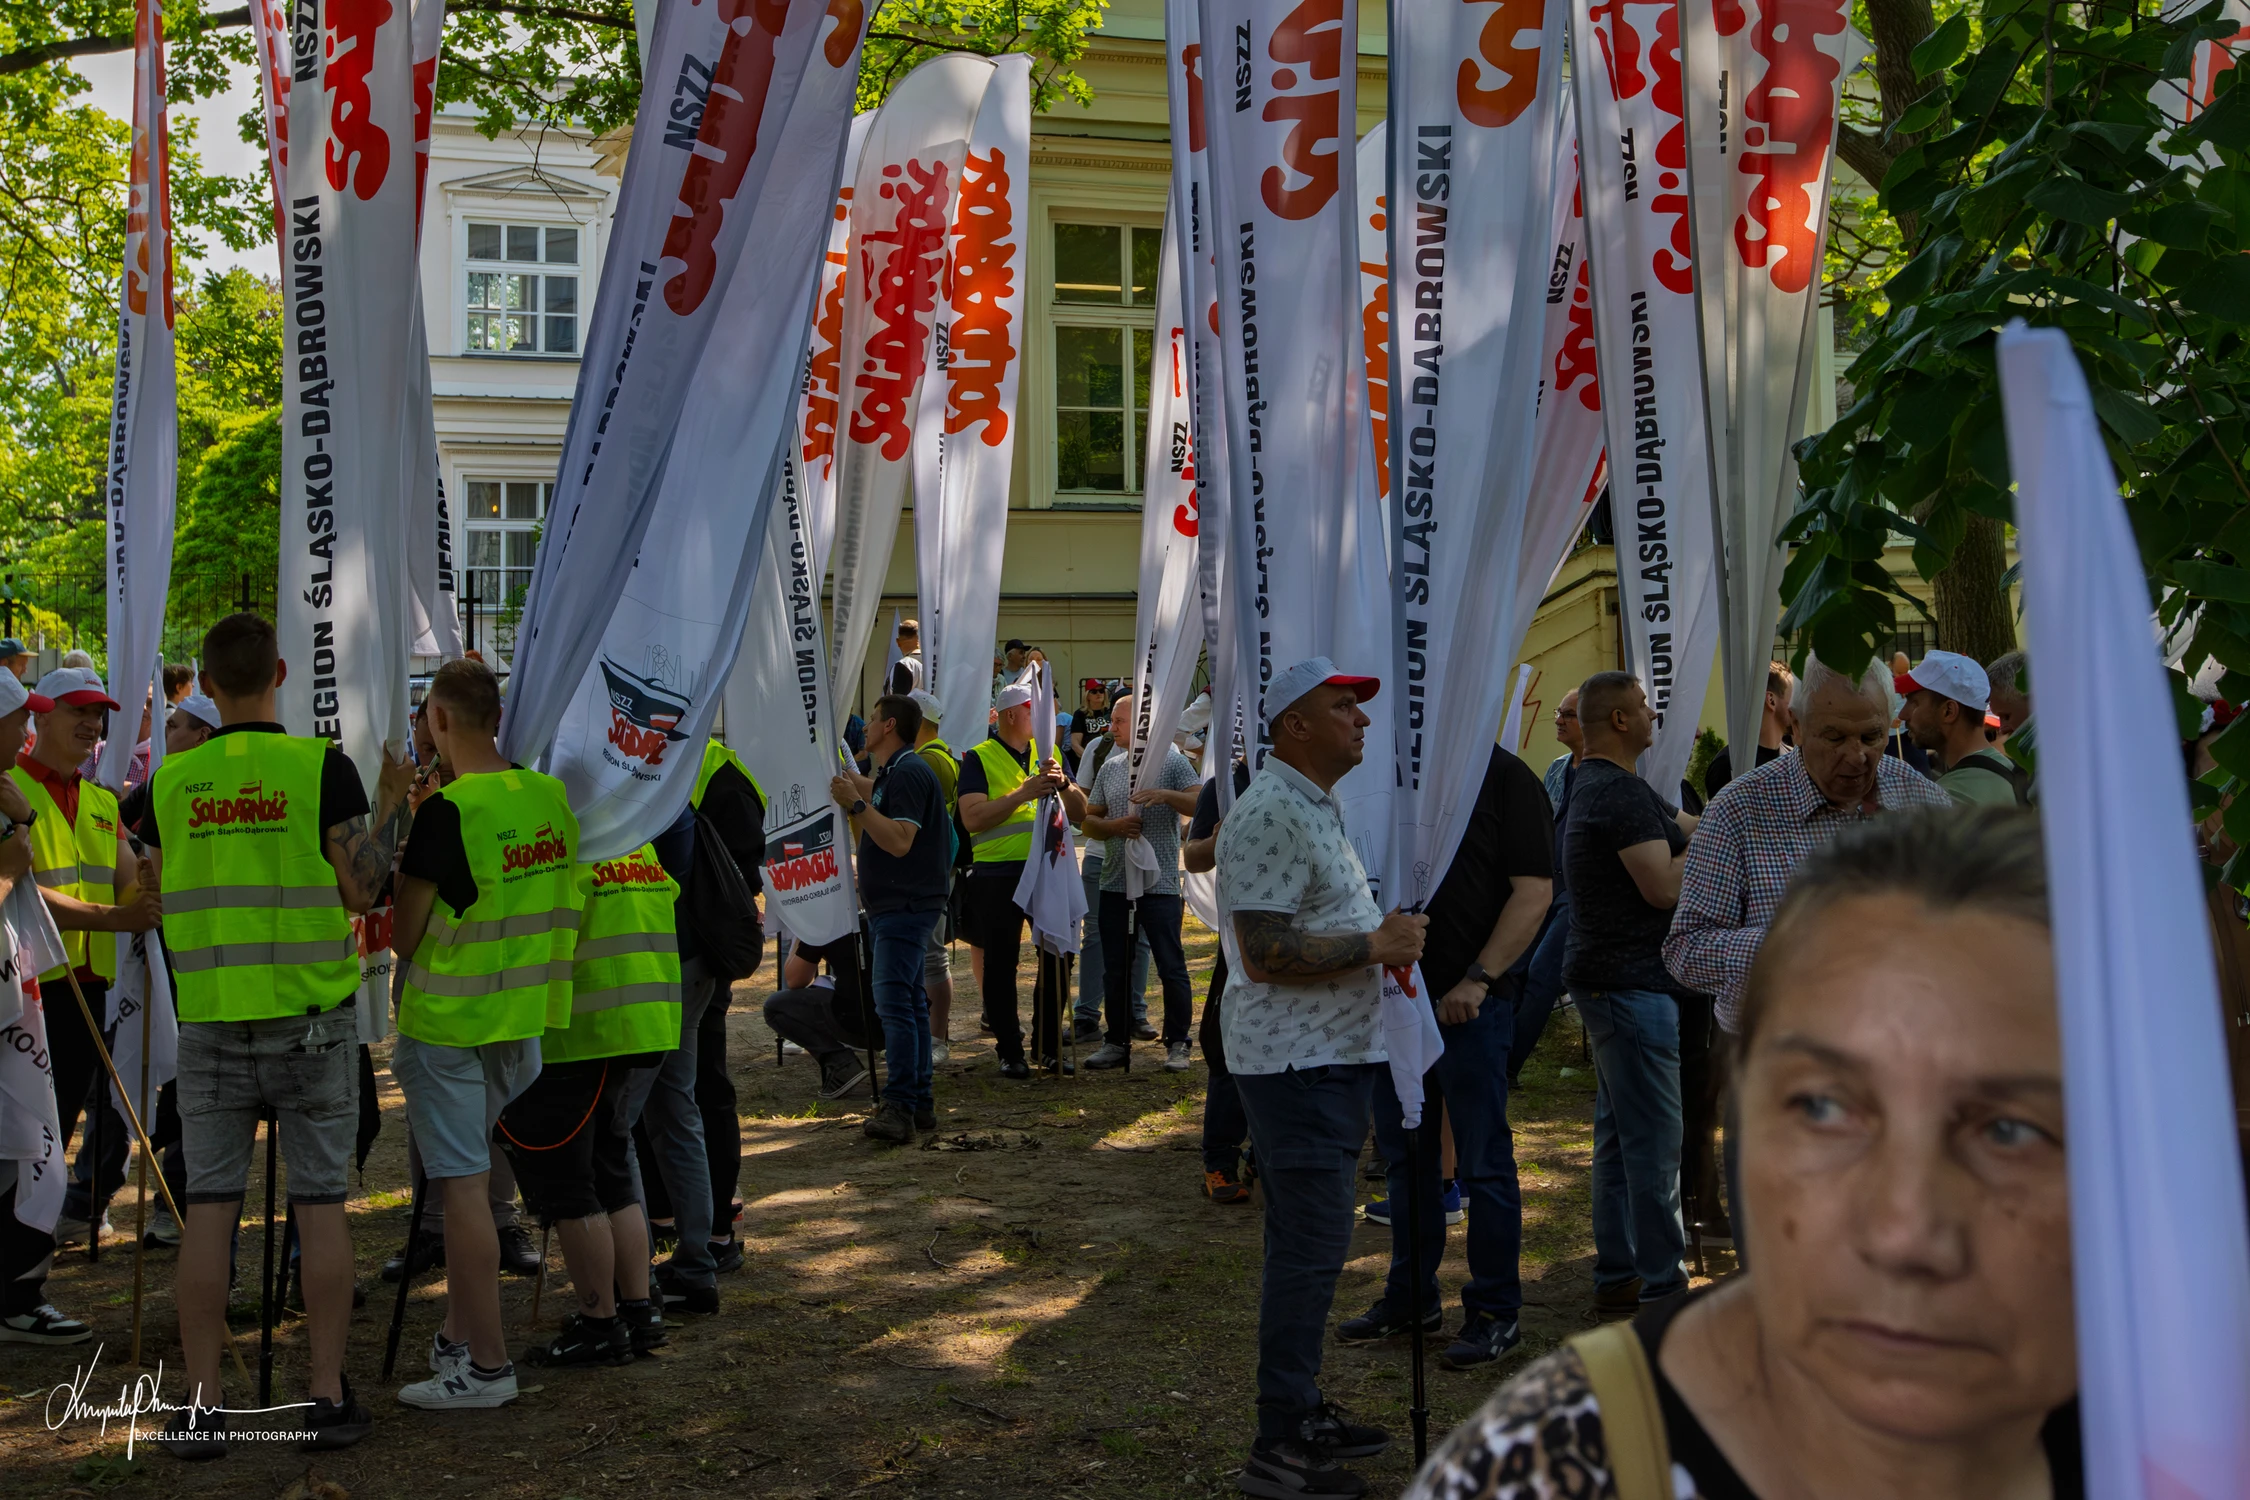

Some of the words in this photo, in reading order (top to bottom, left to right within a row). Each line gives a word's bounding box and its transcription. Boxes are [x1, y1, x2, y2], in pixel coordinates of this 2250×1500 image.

[1236, 19, 1252, 113] NSZZ
[663, 53, 718, 153] NSZZ
[1547, 242, 1575, 304] NSZZ
[936, 322, 950, 372] NSZZ
[293, 195, 338, 608] ŚLĄSKO-DĄBROWSKI
[1170, 421, 1188, 473] NSZZ
[313, 619, 345, 752] EGION
[610, 687, 633, 711] NSZZ
[185, 782, 214, 794] NSZZ
[189, 830, 215, 840] Region
[496, 829, 518, 841] NSZZ
[593, 888, 619, 898] Region
